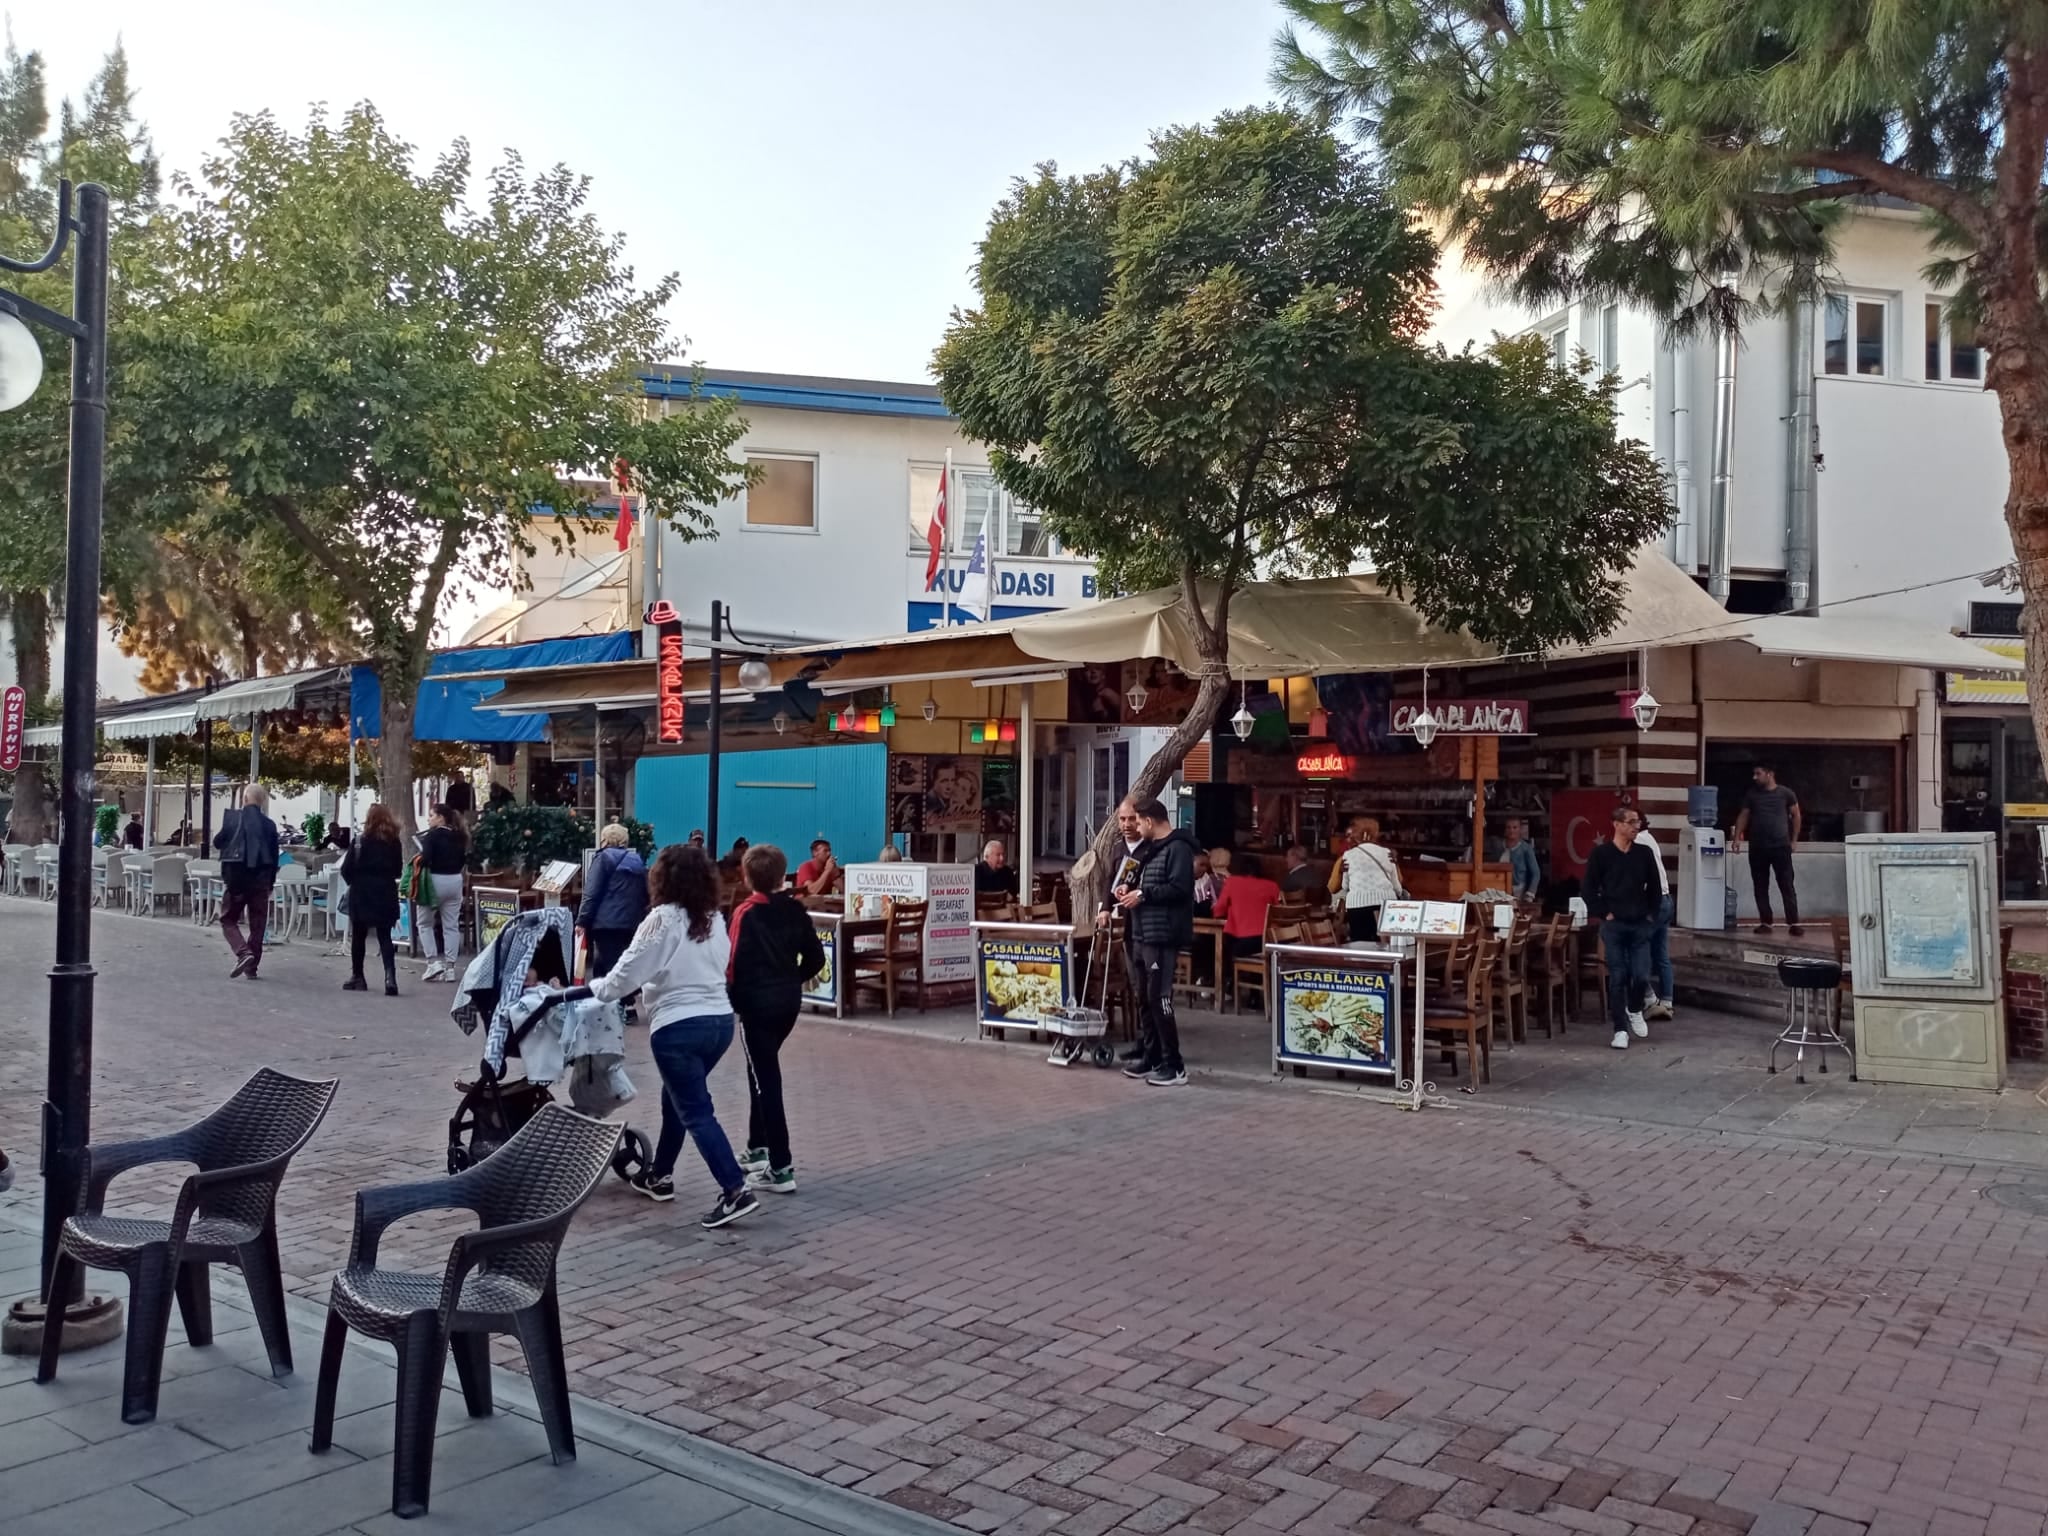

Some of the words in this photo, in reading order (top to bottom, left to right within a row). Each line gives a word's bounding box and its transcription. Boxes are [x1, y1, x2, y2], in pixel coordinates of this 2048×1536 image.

[931, 569, 1054, 597] KUDASI
[660, 636, 683, 740] CASABLANCA
[1393, 701, 1523, 733] CAABLANCA
[1298, 754, 1344, 772] CASABLANCA
[856, 872, 914, 887] CASABLANCA
[931, 889, 945, 897] SAN
[947, 887, 970, 896] MARCO
[936, 899, 965, 911] BREAKFAST
[983, 942, 1062, 959] CASABLANCA
[1297, 981, 1318, 989] SPORTS
[1335, 984, 1373, 993] RESTAURANT
